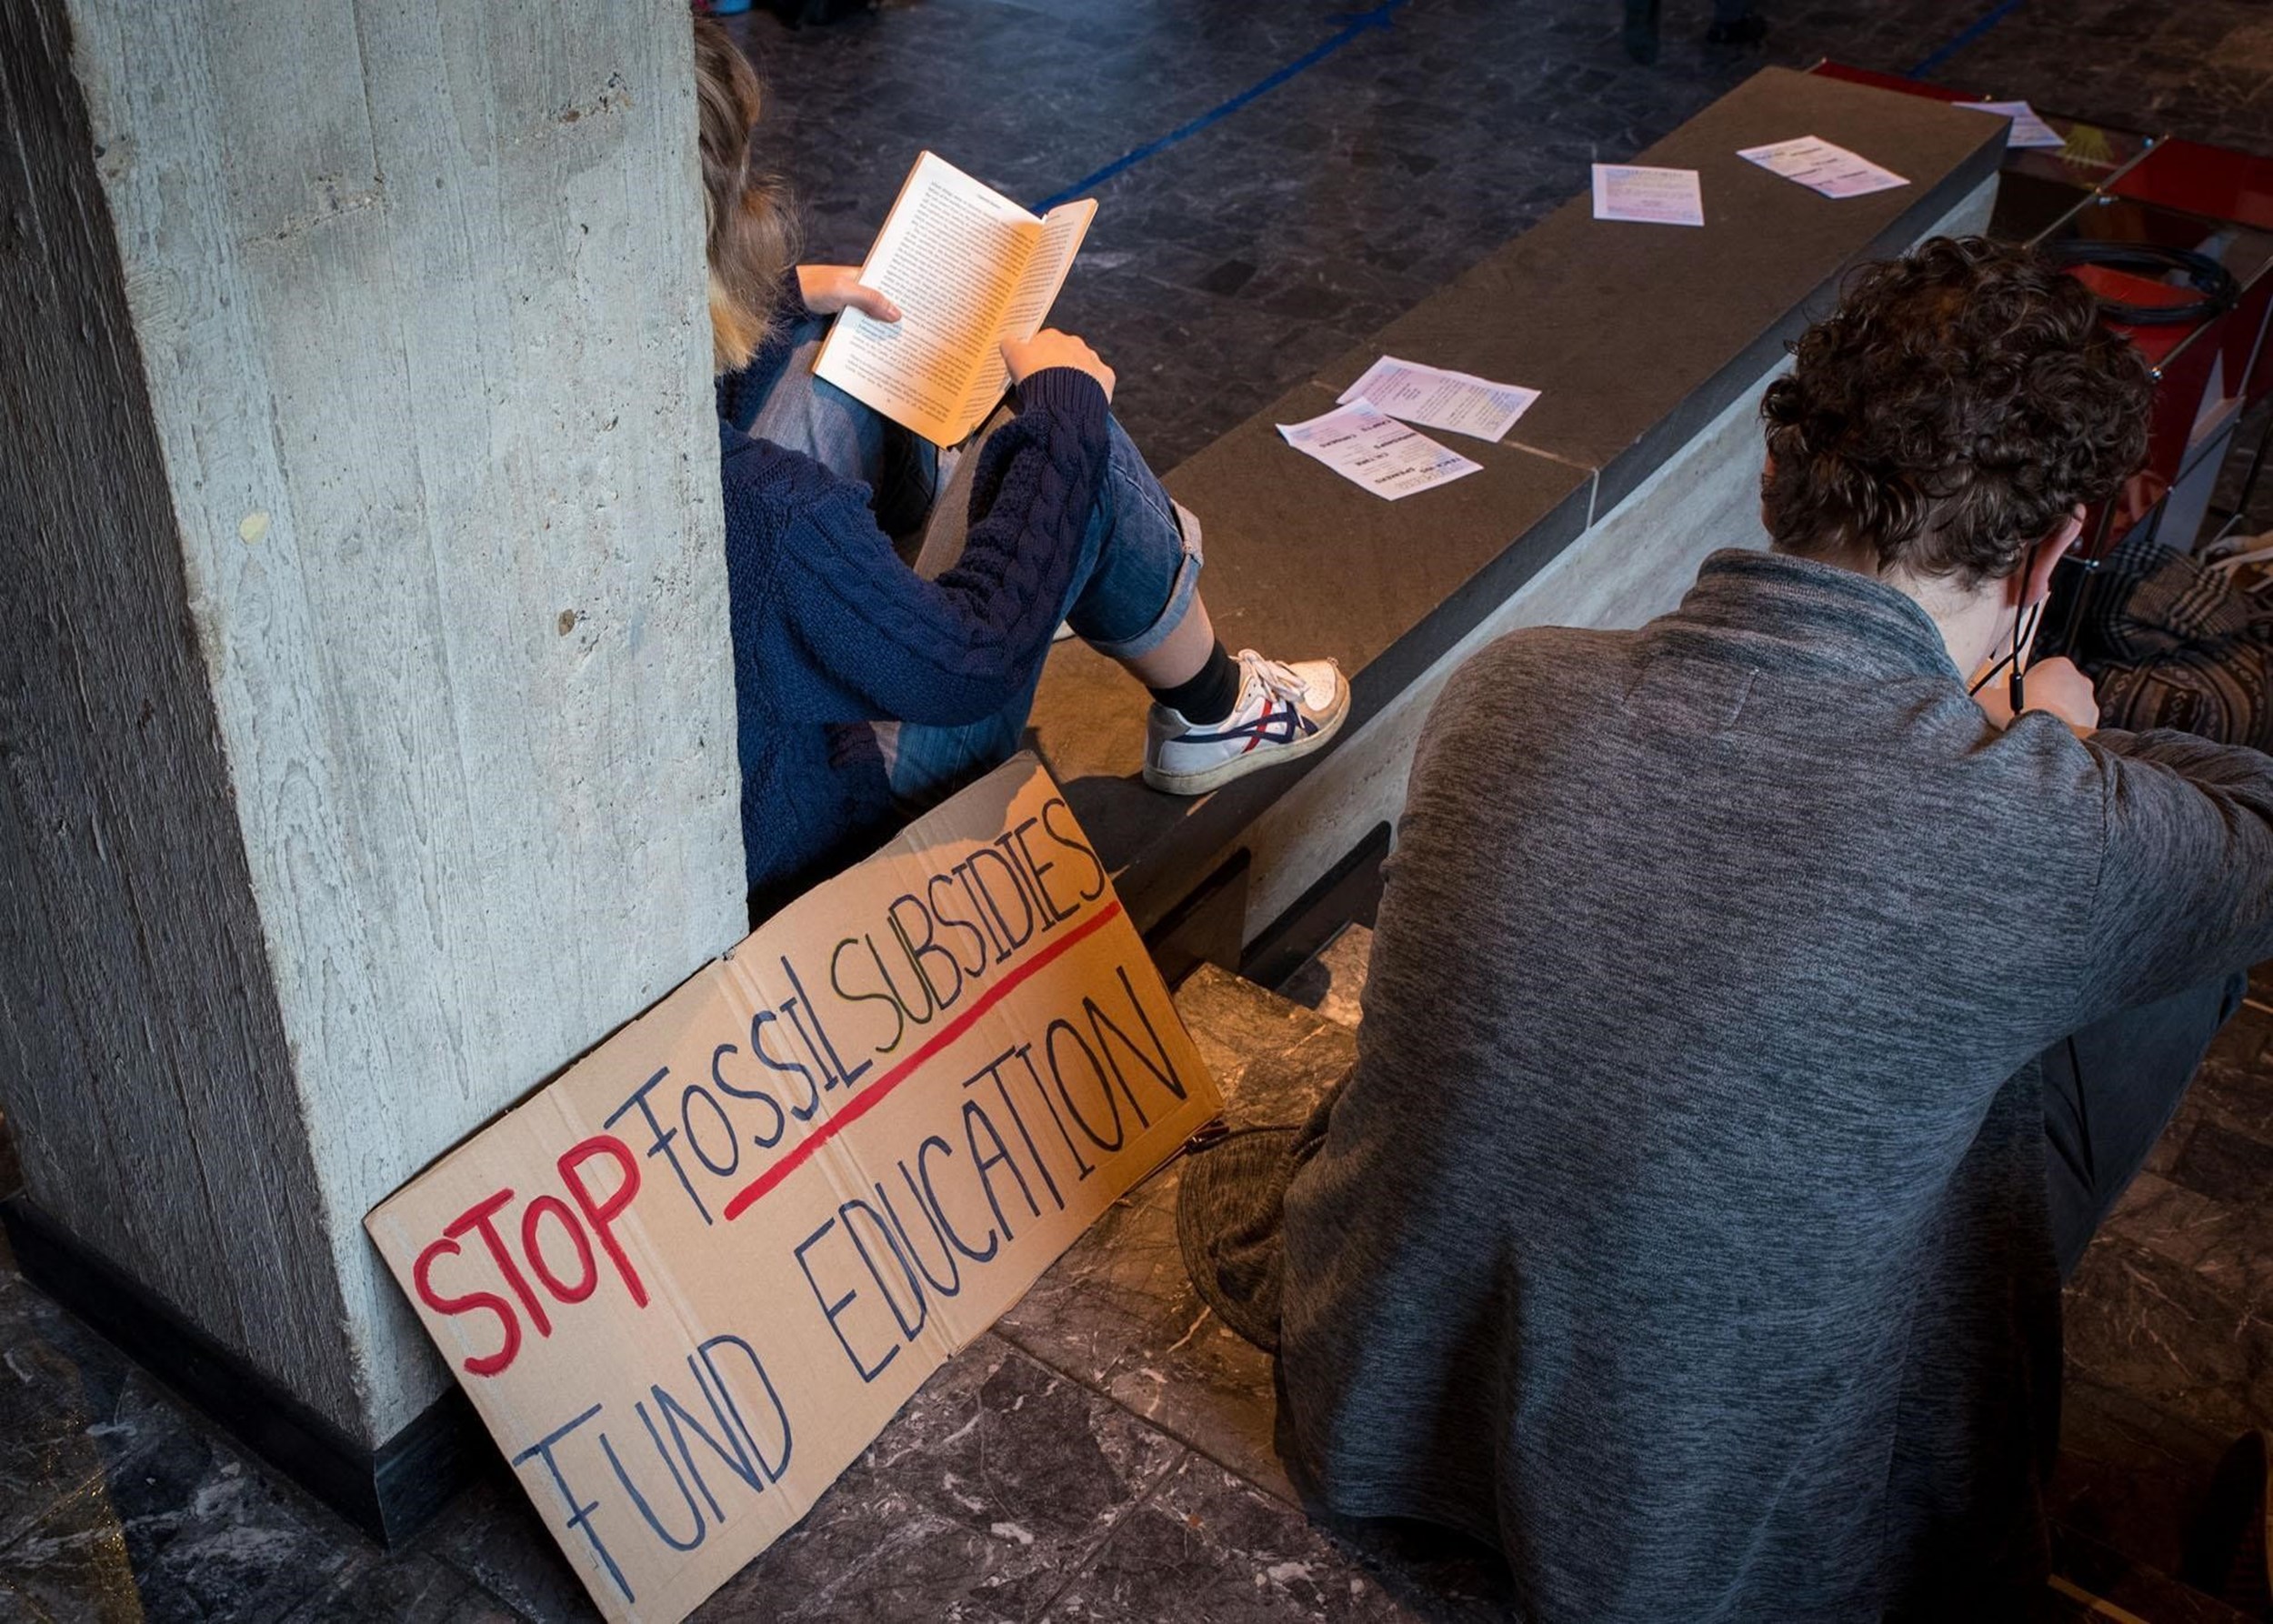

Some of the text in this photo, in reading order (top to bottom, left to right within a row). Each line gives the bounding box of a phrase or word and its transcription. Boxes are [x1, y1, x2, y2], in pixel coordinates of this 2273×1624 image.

[414, 797, 1105, 1378] STOP FOSSIL SUBSIDIES
[513, 966, 1186, 1604] FUND EDUCATION
